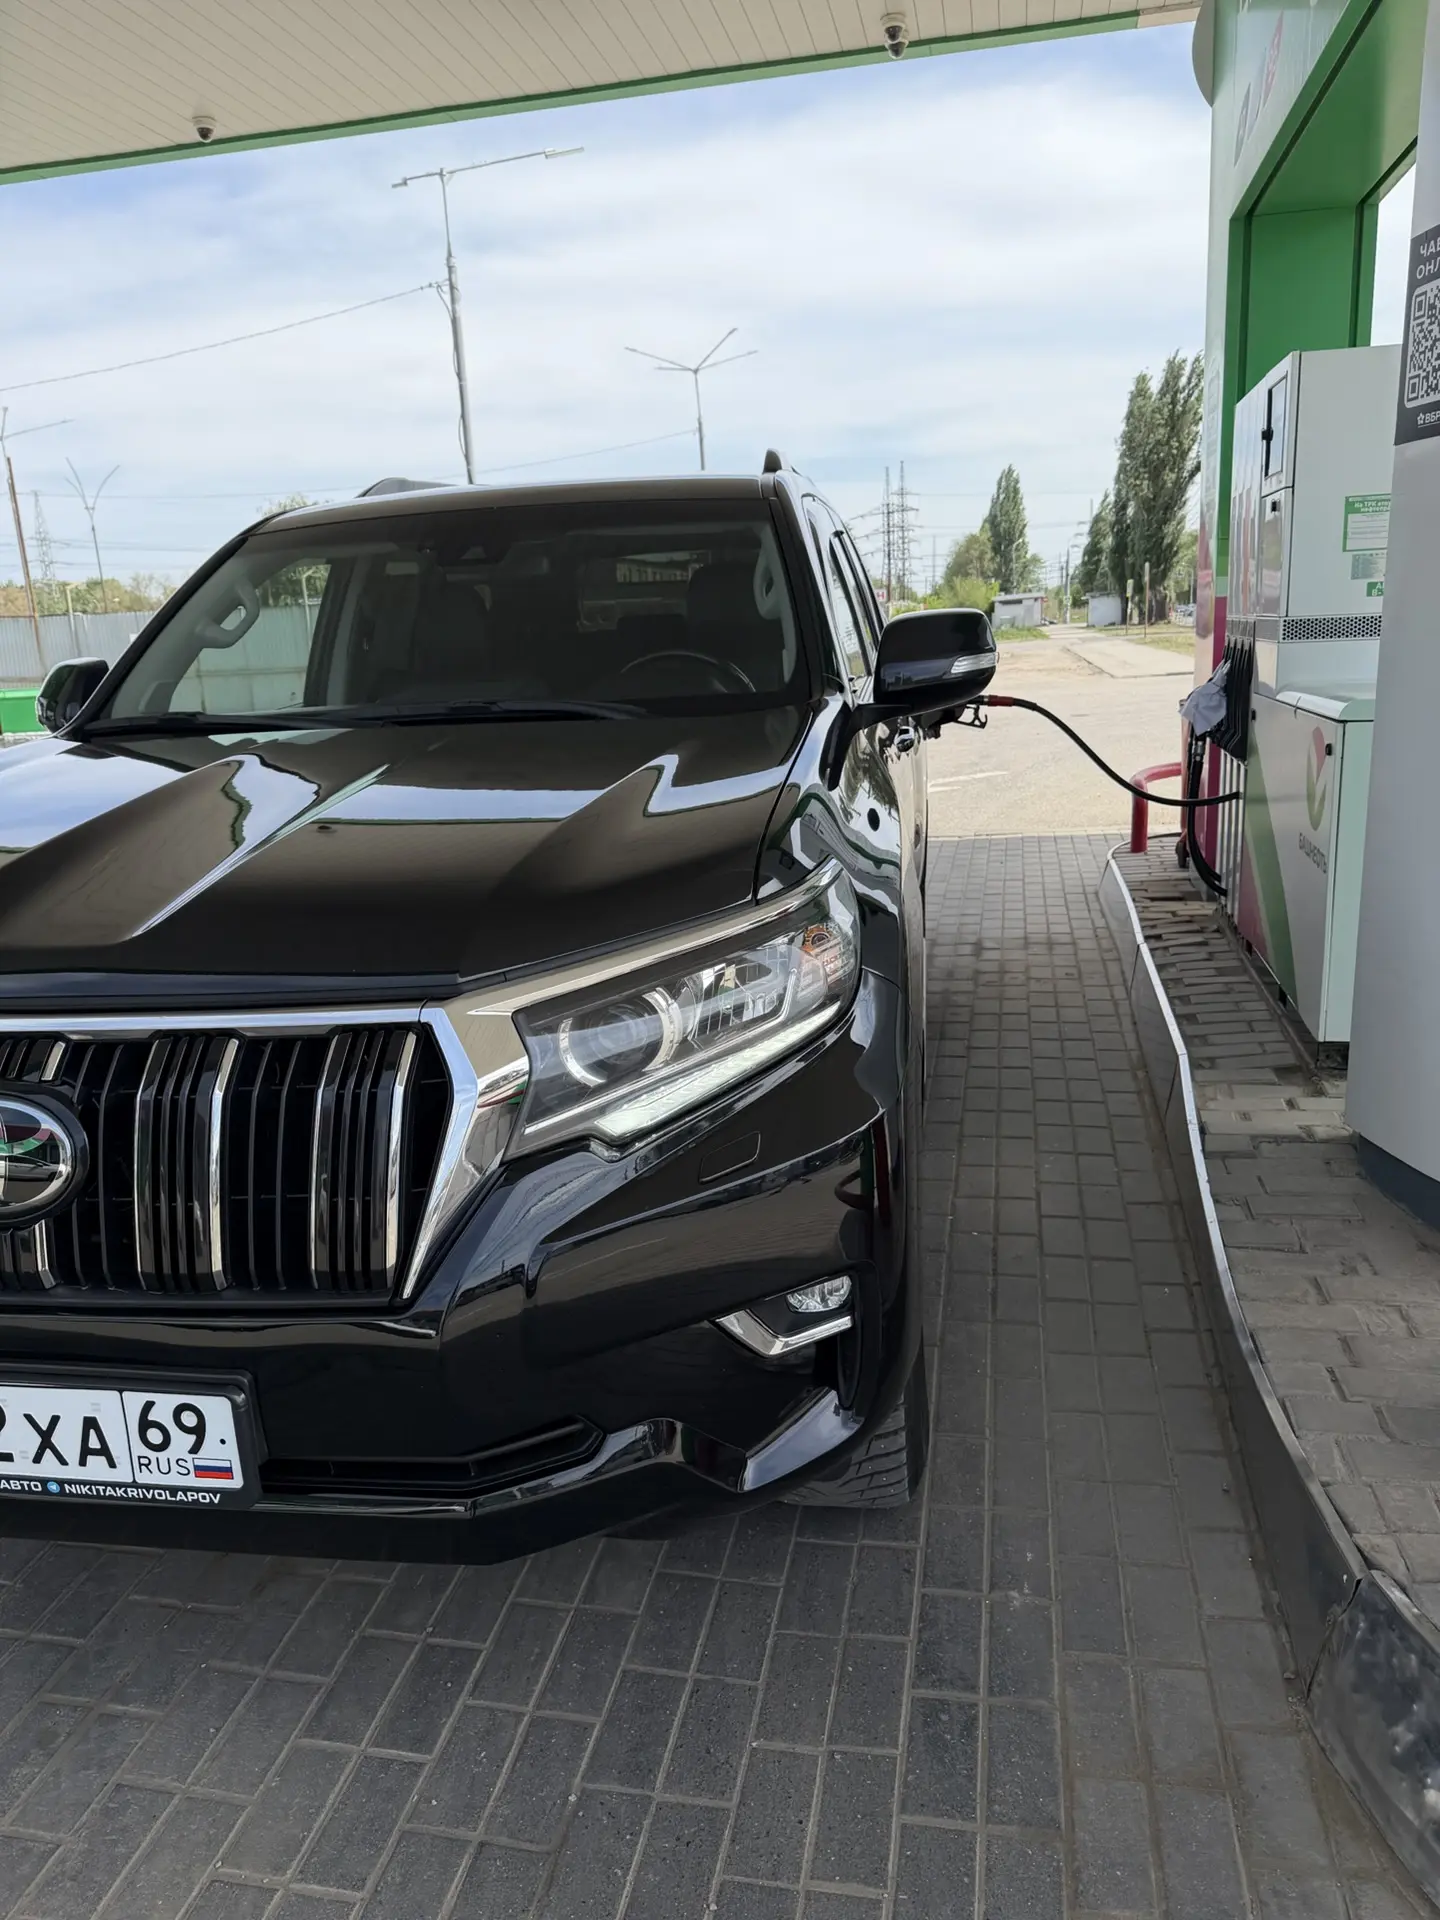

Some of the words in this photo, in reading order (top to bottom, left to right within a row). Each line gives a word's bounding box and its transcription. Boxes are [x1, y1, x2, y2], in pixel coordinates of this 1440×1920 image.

[138, 1400, 206, 1454] 69
[137, 1456, 191, 1476] RUS
[64, 1483, 220, 1504] NIKITAKRIVOLAPOV
